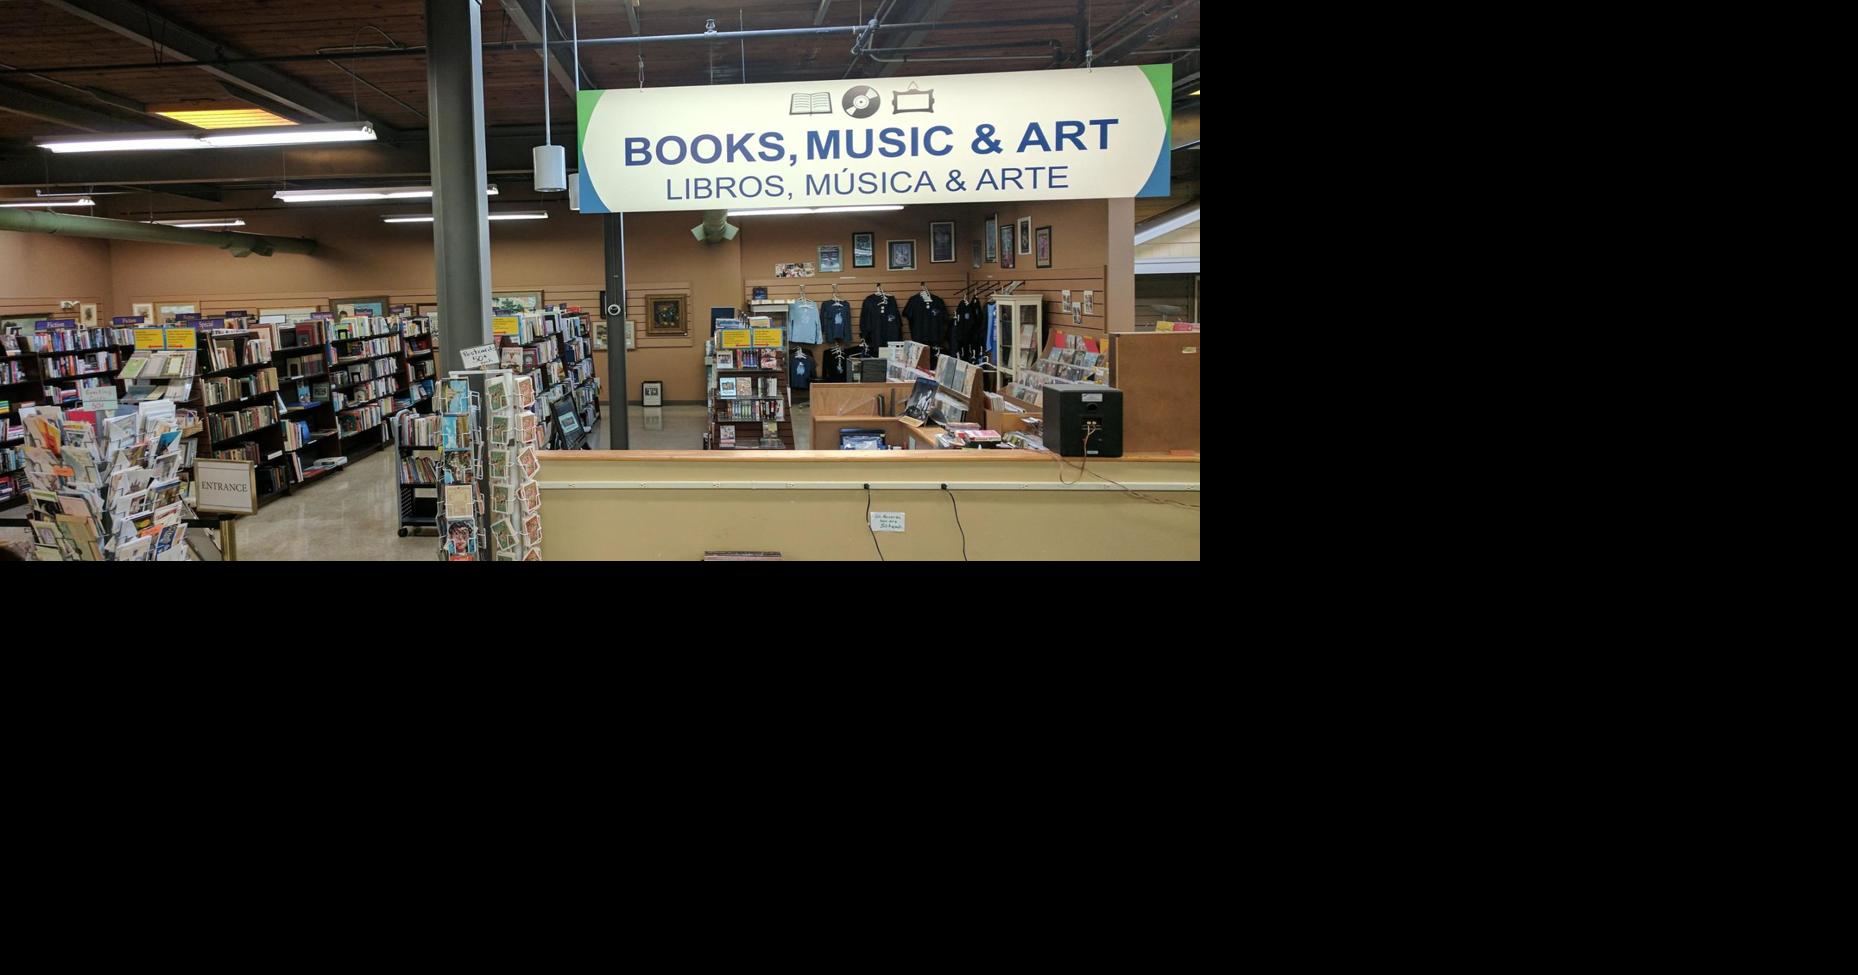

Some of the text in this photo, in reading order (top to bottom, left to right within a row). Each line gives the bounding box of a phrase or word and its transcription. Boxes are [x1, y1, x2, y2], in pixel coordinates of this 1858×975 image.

[624, 118, 1120, 168] BOOKS, MUSIC & ART
[666, 165, 1069, 201] LIBROS, MÚSICA & ARTE
[201, 480, 249, 493] ENTRANCE
